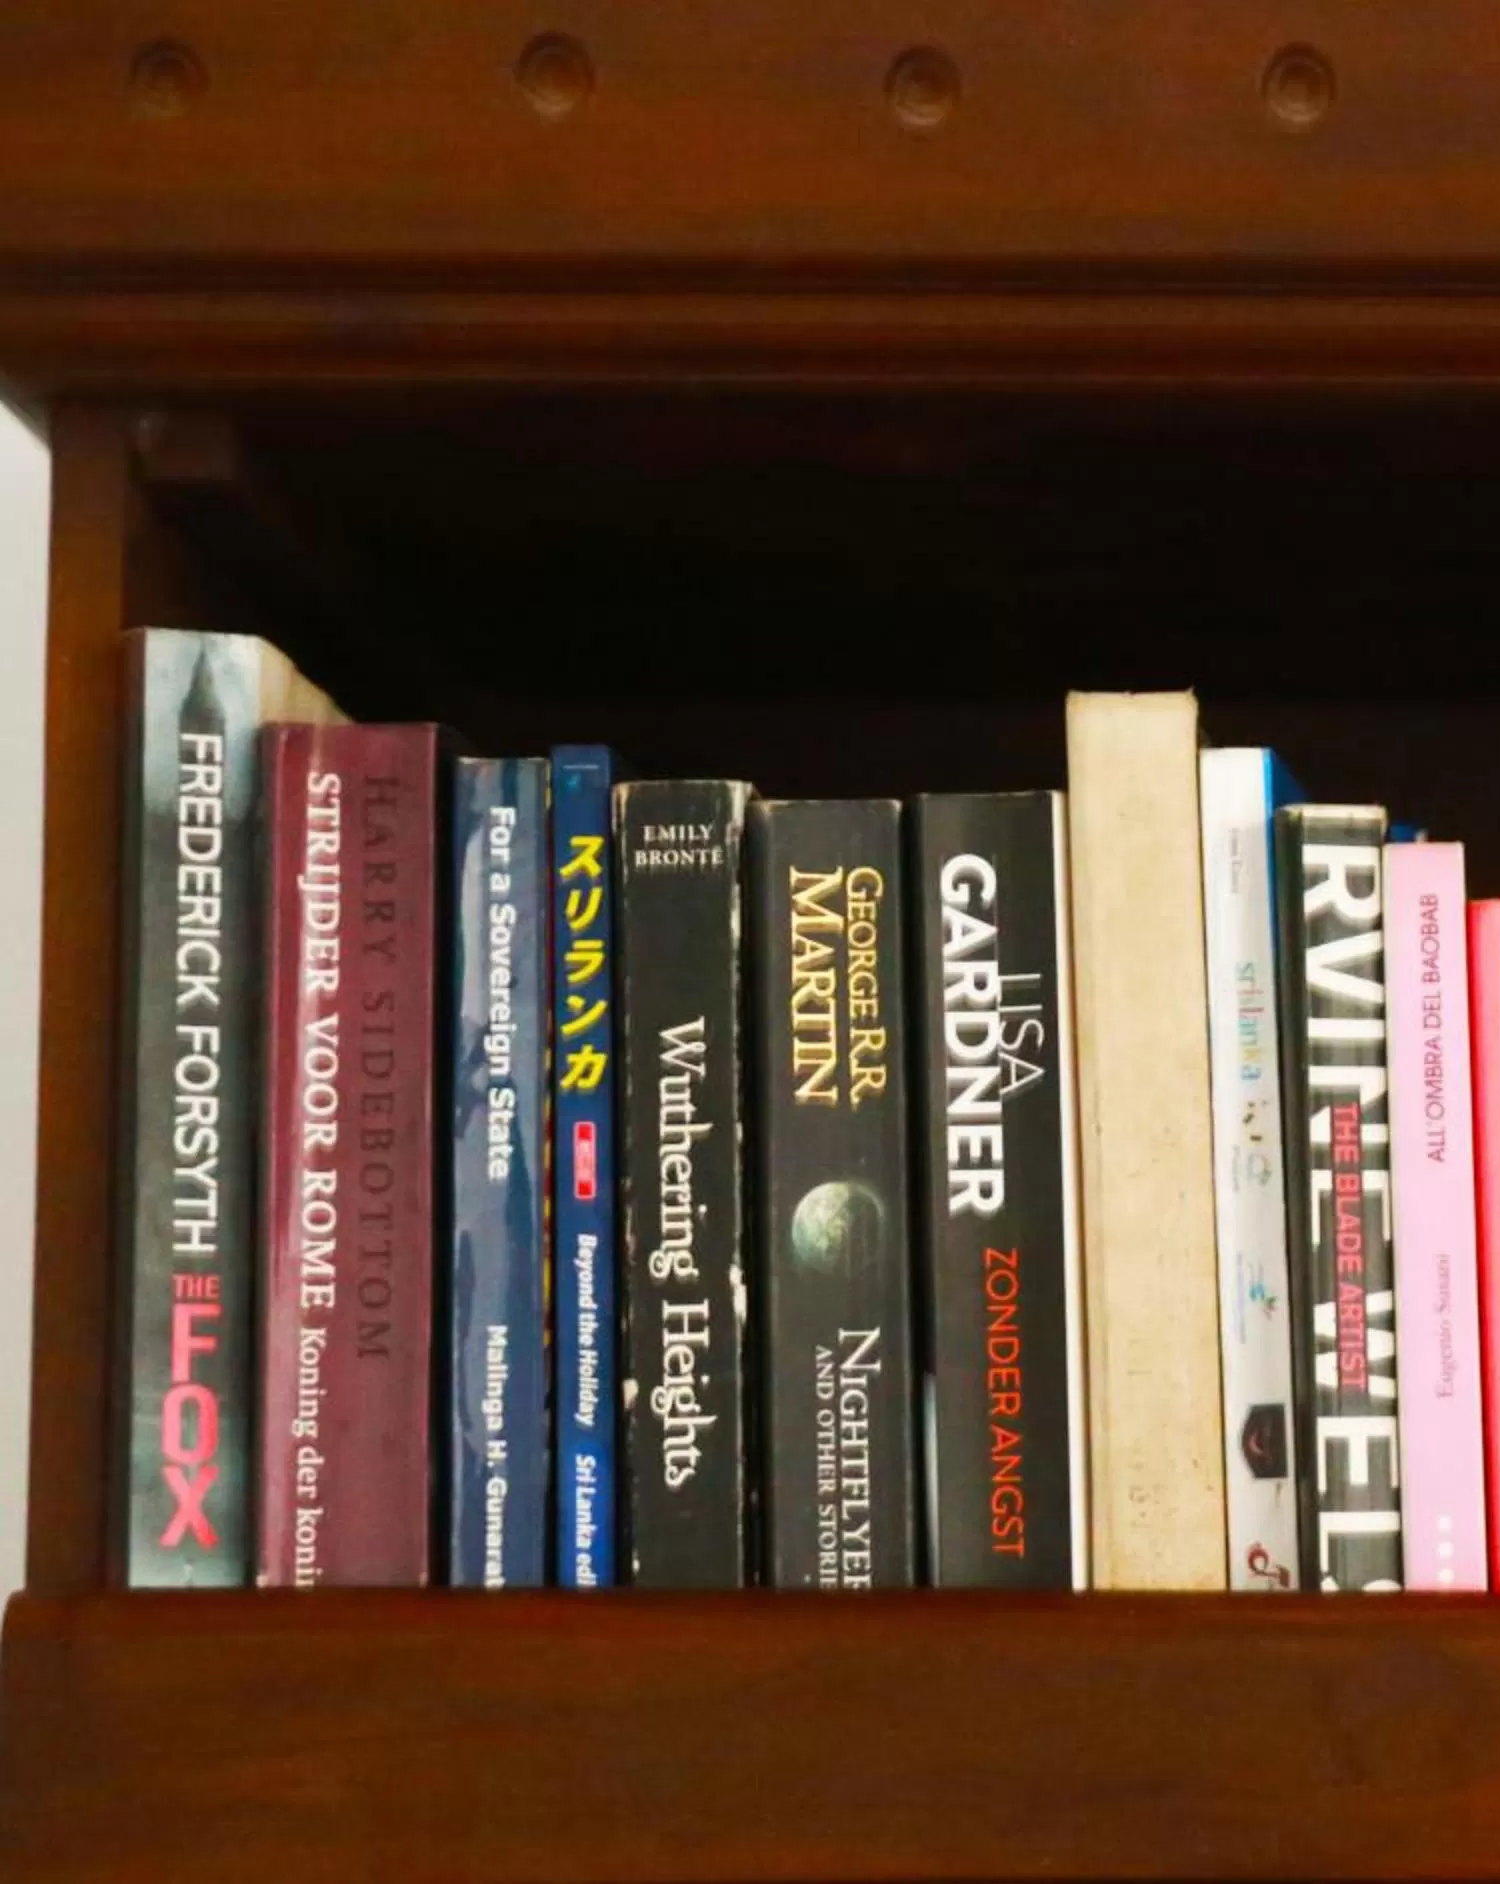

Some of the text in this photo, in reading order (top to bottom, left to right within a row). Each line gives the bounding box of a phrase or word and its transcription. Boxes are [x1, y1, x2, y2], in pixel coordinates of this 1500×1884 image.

[643, 824, 714, 841] EMILY
[846, 866, 884, 1019] GEORGE
[172, 733, 224, 1254] FREDERICK FORSYTH
[298, 771, 341, 1309] STRIJDER VOOR ROME
[358, 775, 398, 1359] HARRY SIDEBOTTOM
[484, 807, 517, 1182] For a Sovereign State
[559, 836, 609, 1092] スリランカ
[789, 866, 844, 1106] MARTIN
[940, 853, 1005, 1217] GARDNER
[997, 973, 1045, 1096] LISA
[1420, 893, 1445, 1163] ALL'OMBRA DEL BAOBAB
[173, 1273, 220, 1297] THE
[572, 1233, 597, 1310] Beyond
[576, 1313, 597, 1346] the
[649, 1015, 717, 1488] Wuthering Heights
[1333, 1103, 1367, 1391] THE BLADE ARTIST
[160, 1303, 221, 1549] FOX
[292, 1328, 328, 1438] Koning
[296, 1446, 325, 1498] der
[481, 1325, 509, 1590] Malinga H. Gunarat
[573, 1350, 598, 1427] Holiday
[576, 1454, 596, 1482] Sri
[815, 1346, 835, 1401] AND
[816, 1409, 836, 1494] OTHER
[984, 1247, 1025, 1559] ZONDER ANGST
[1313, 1290, 1404, 1592] WEL
[576, 1487, 597, 1548] Lanka
